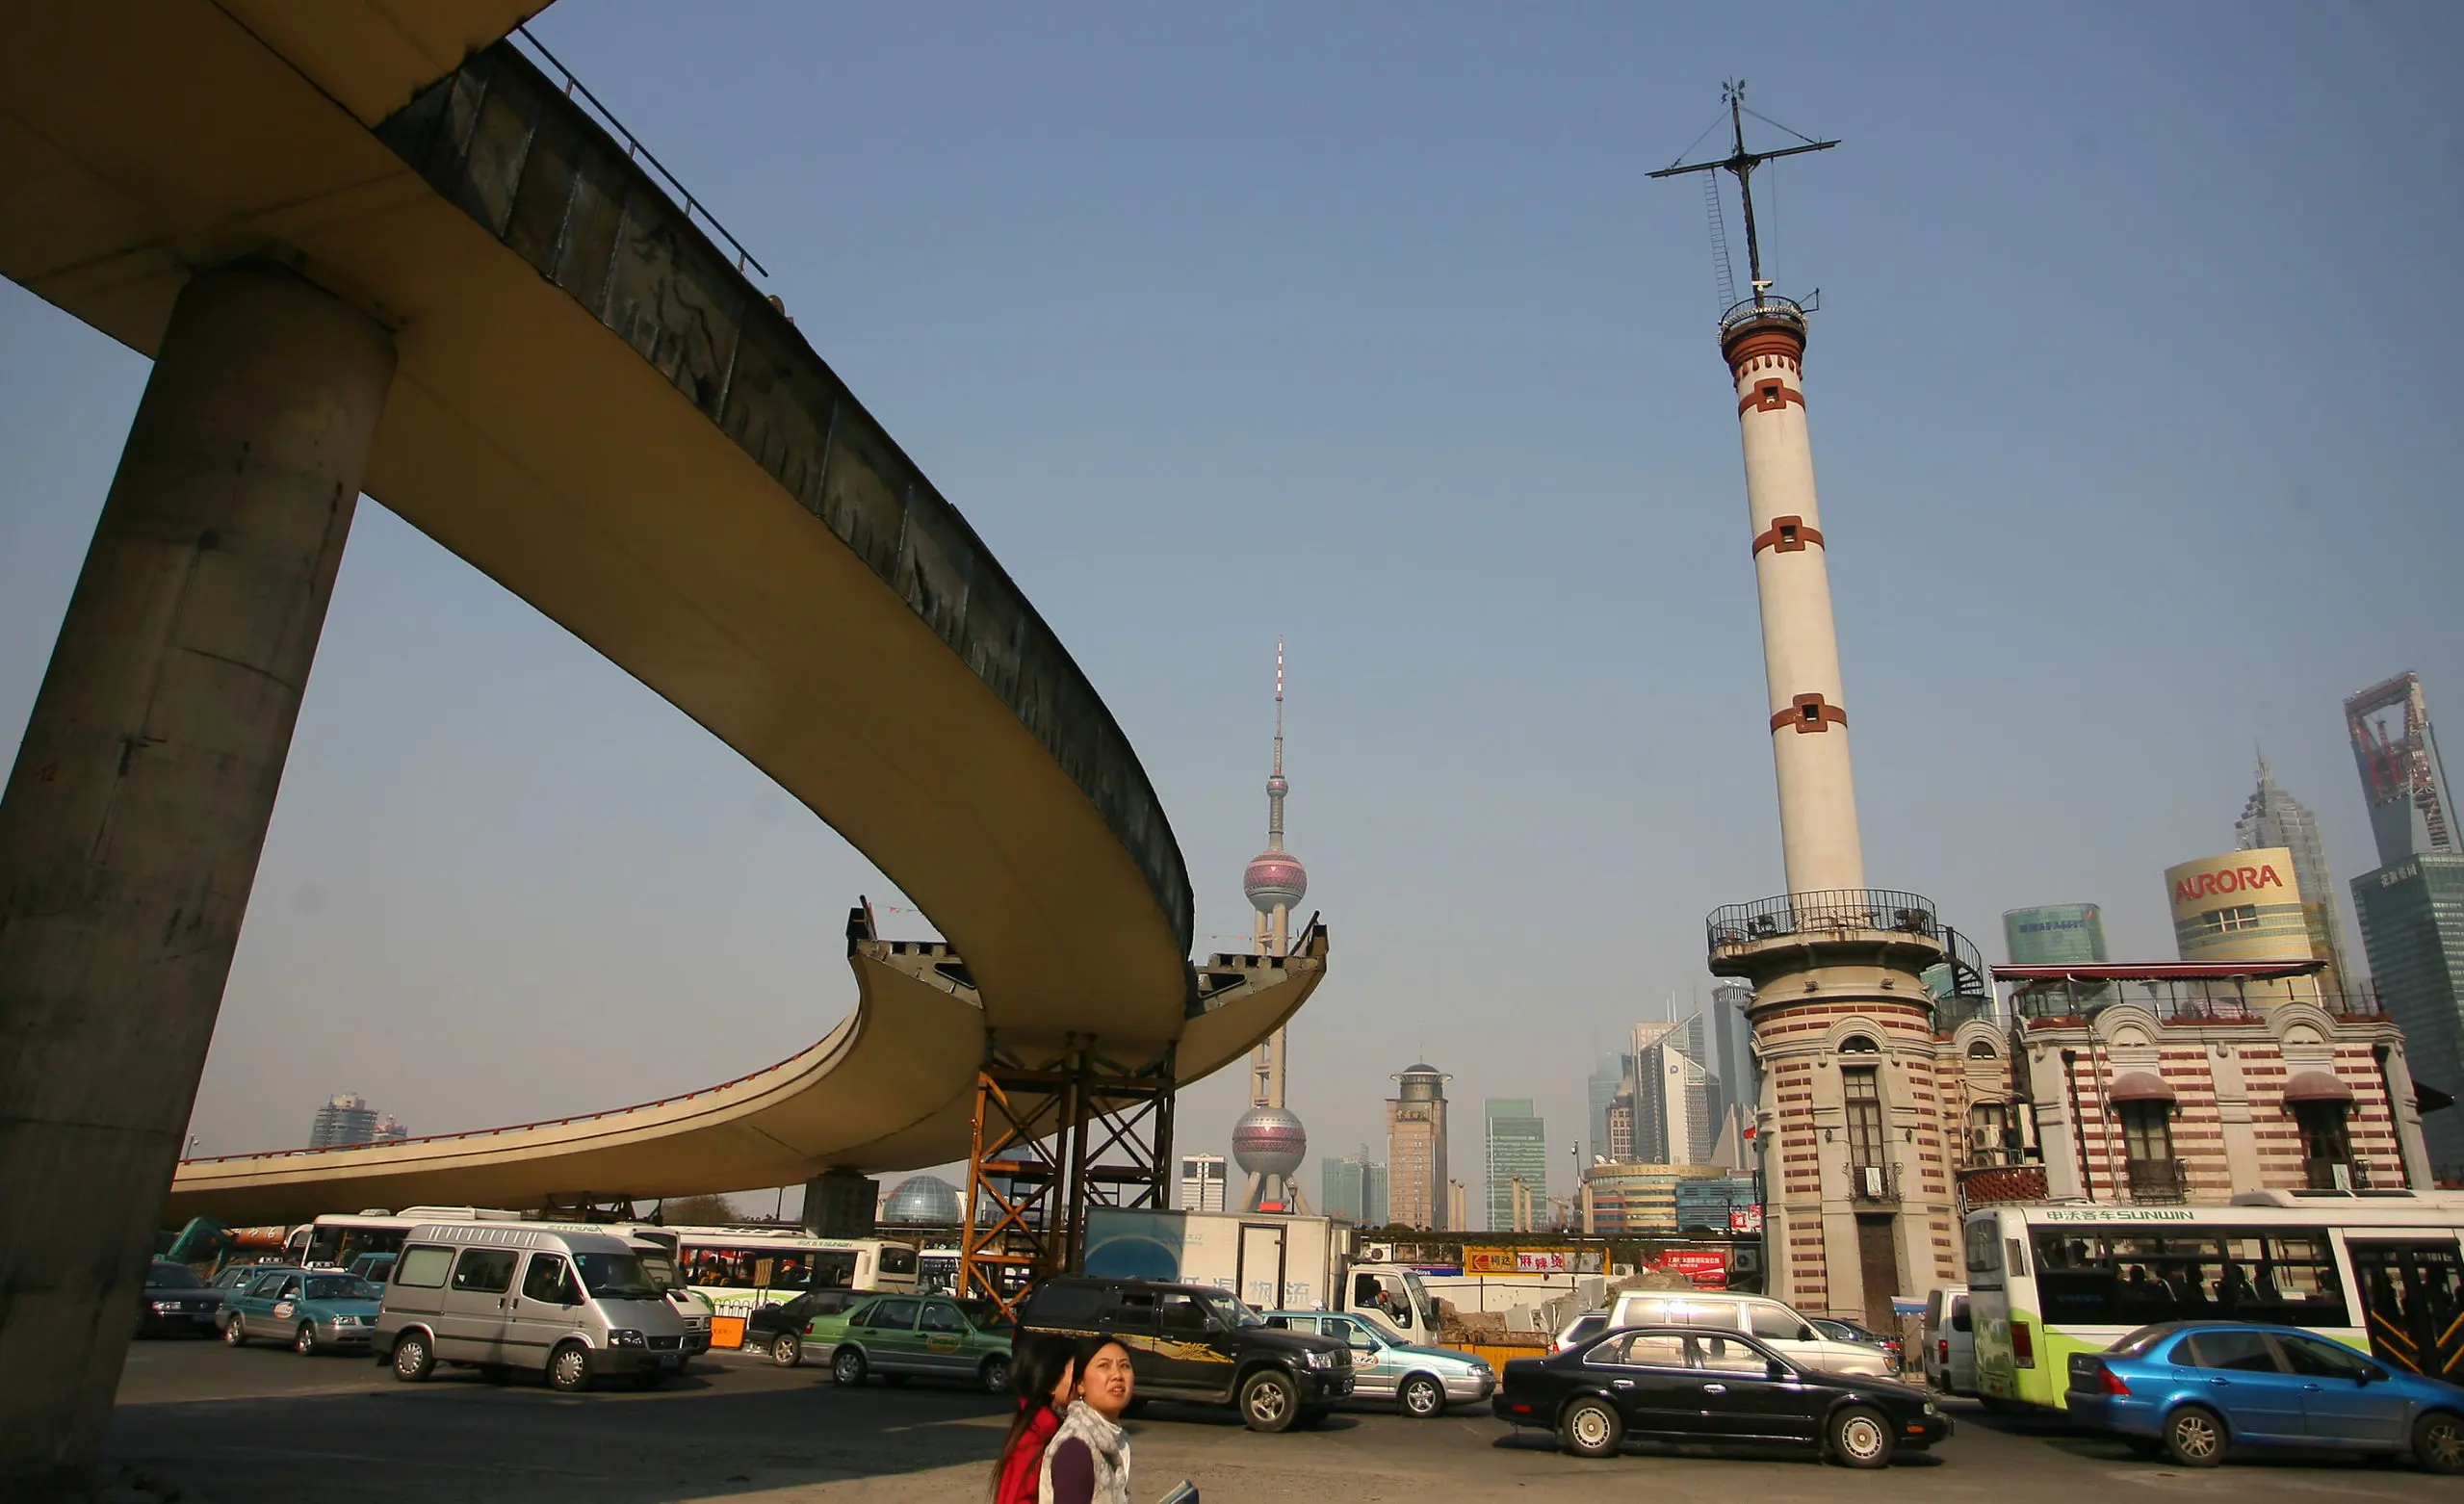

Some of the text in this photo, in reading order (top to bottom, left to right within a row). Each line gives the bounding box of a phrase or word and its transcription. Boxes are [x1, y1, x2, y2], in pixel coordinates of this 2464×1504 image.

[2176, 865, 2283, 904] AURORA
[2047, 1210, 2194, 1220] 申沃客车 SUNWIN
